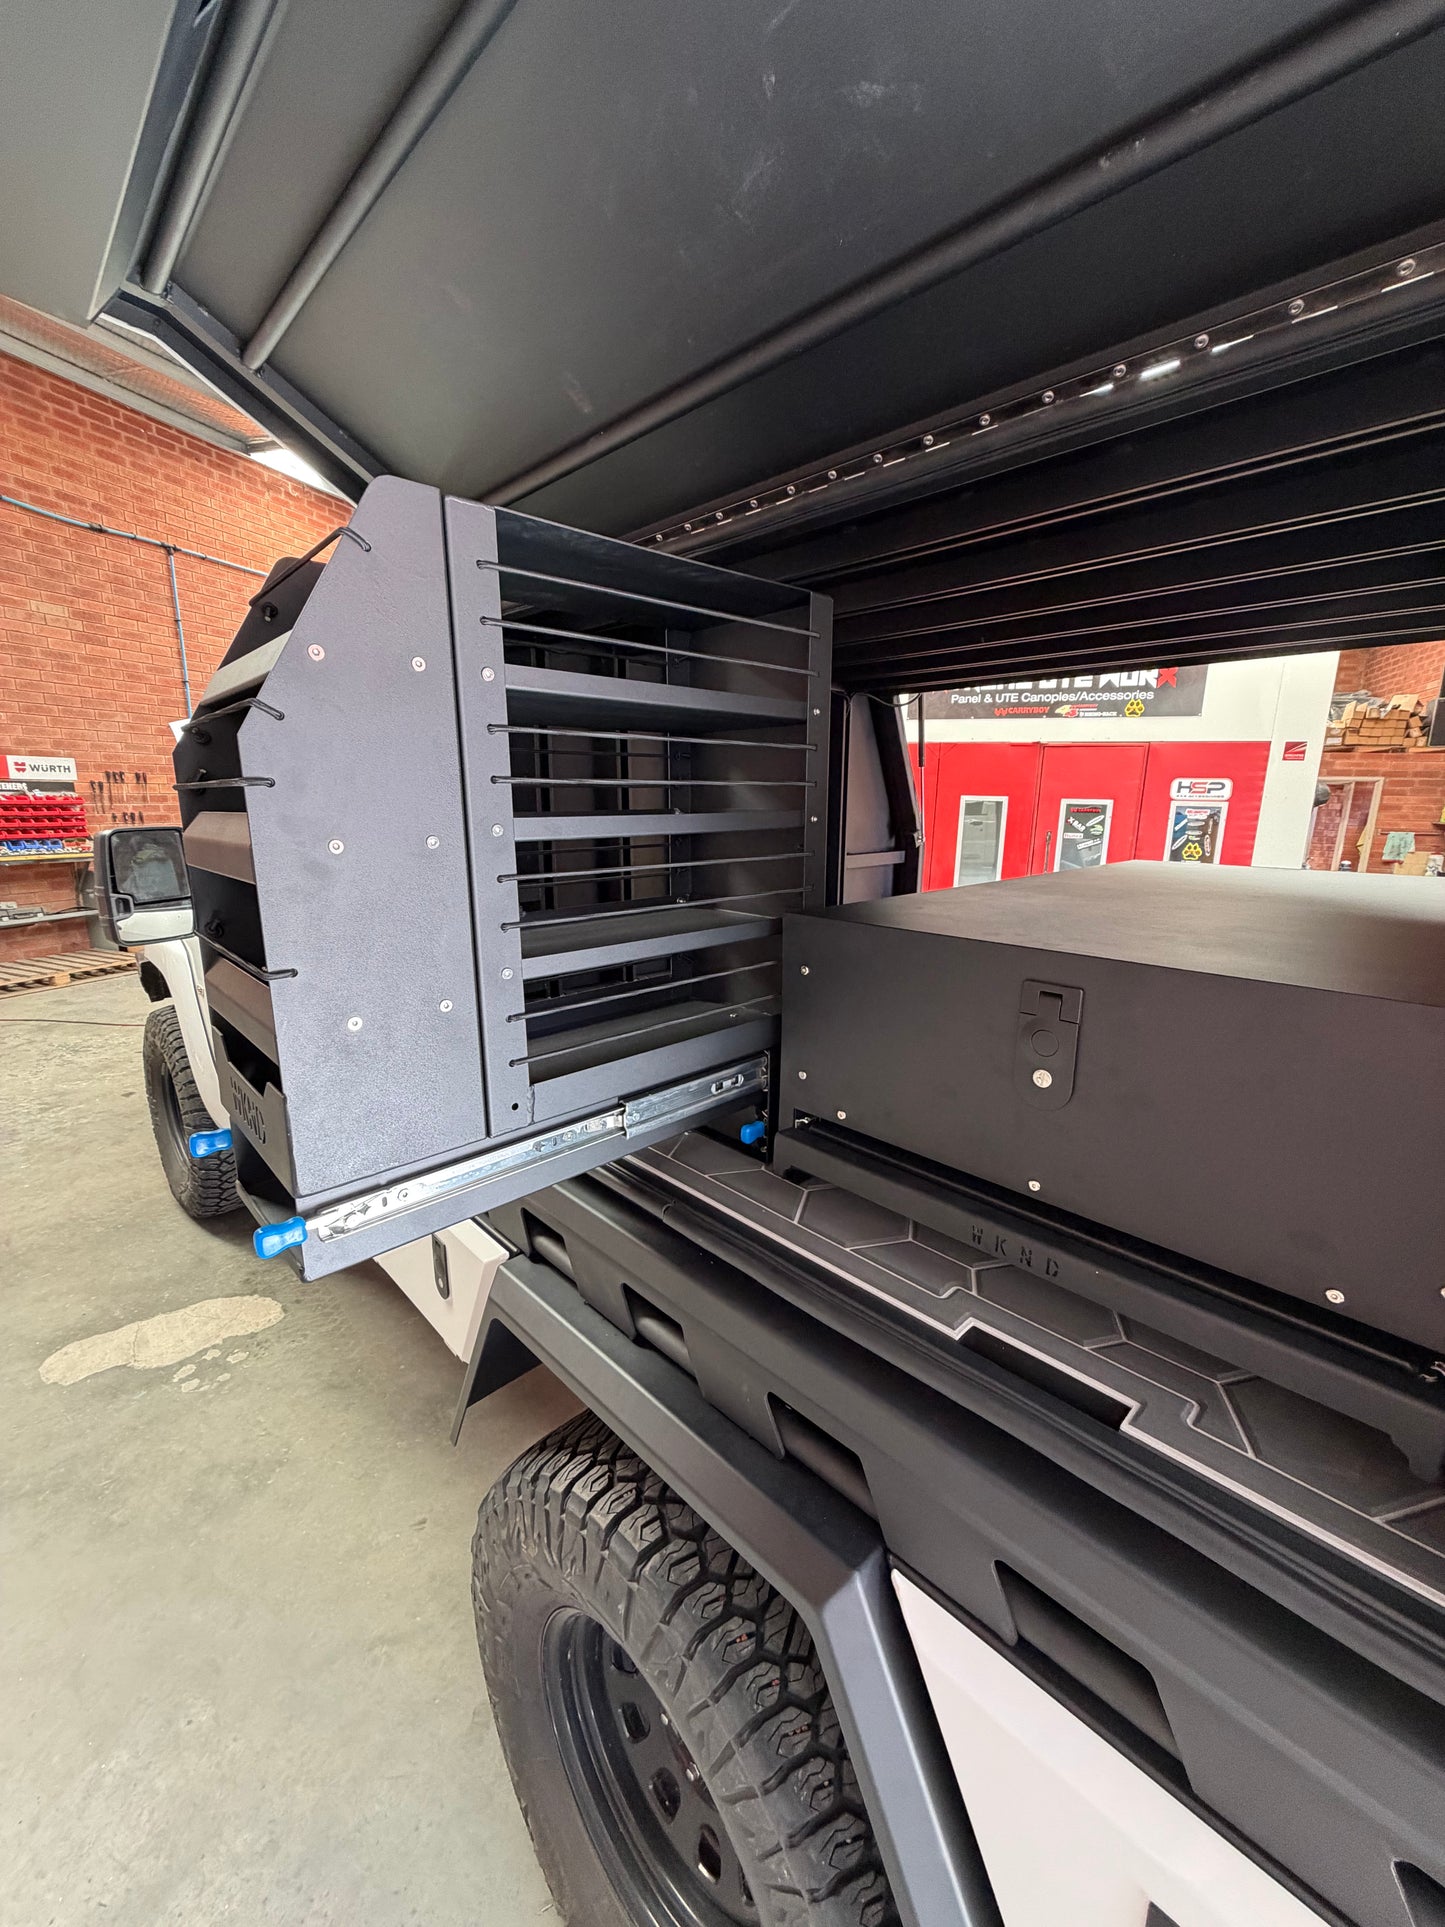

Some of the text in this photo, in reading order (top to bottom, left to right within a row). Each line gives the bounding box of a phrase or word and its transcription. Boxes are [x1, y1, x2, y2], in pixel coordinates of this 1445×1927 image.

[951, 693, 981, 704] Panel
[983, 693, 993, 703] &
[995, 692, 1019, 703] UTE
[1007, 706, 1050, 715] CARRYBOY
[29, 763, 71, 773] WÜRTH
[1176, 781, 1226, 794] HSP
[230, 1076, 266, 1145] WKND
[972, 1225, 1059, 1277] WKND
